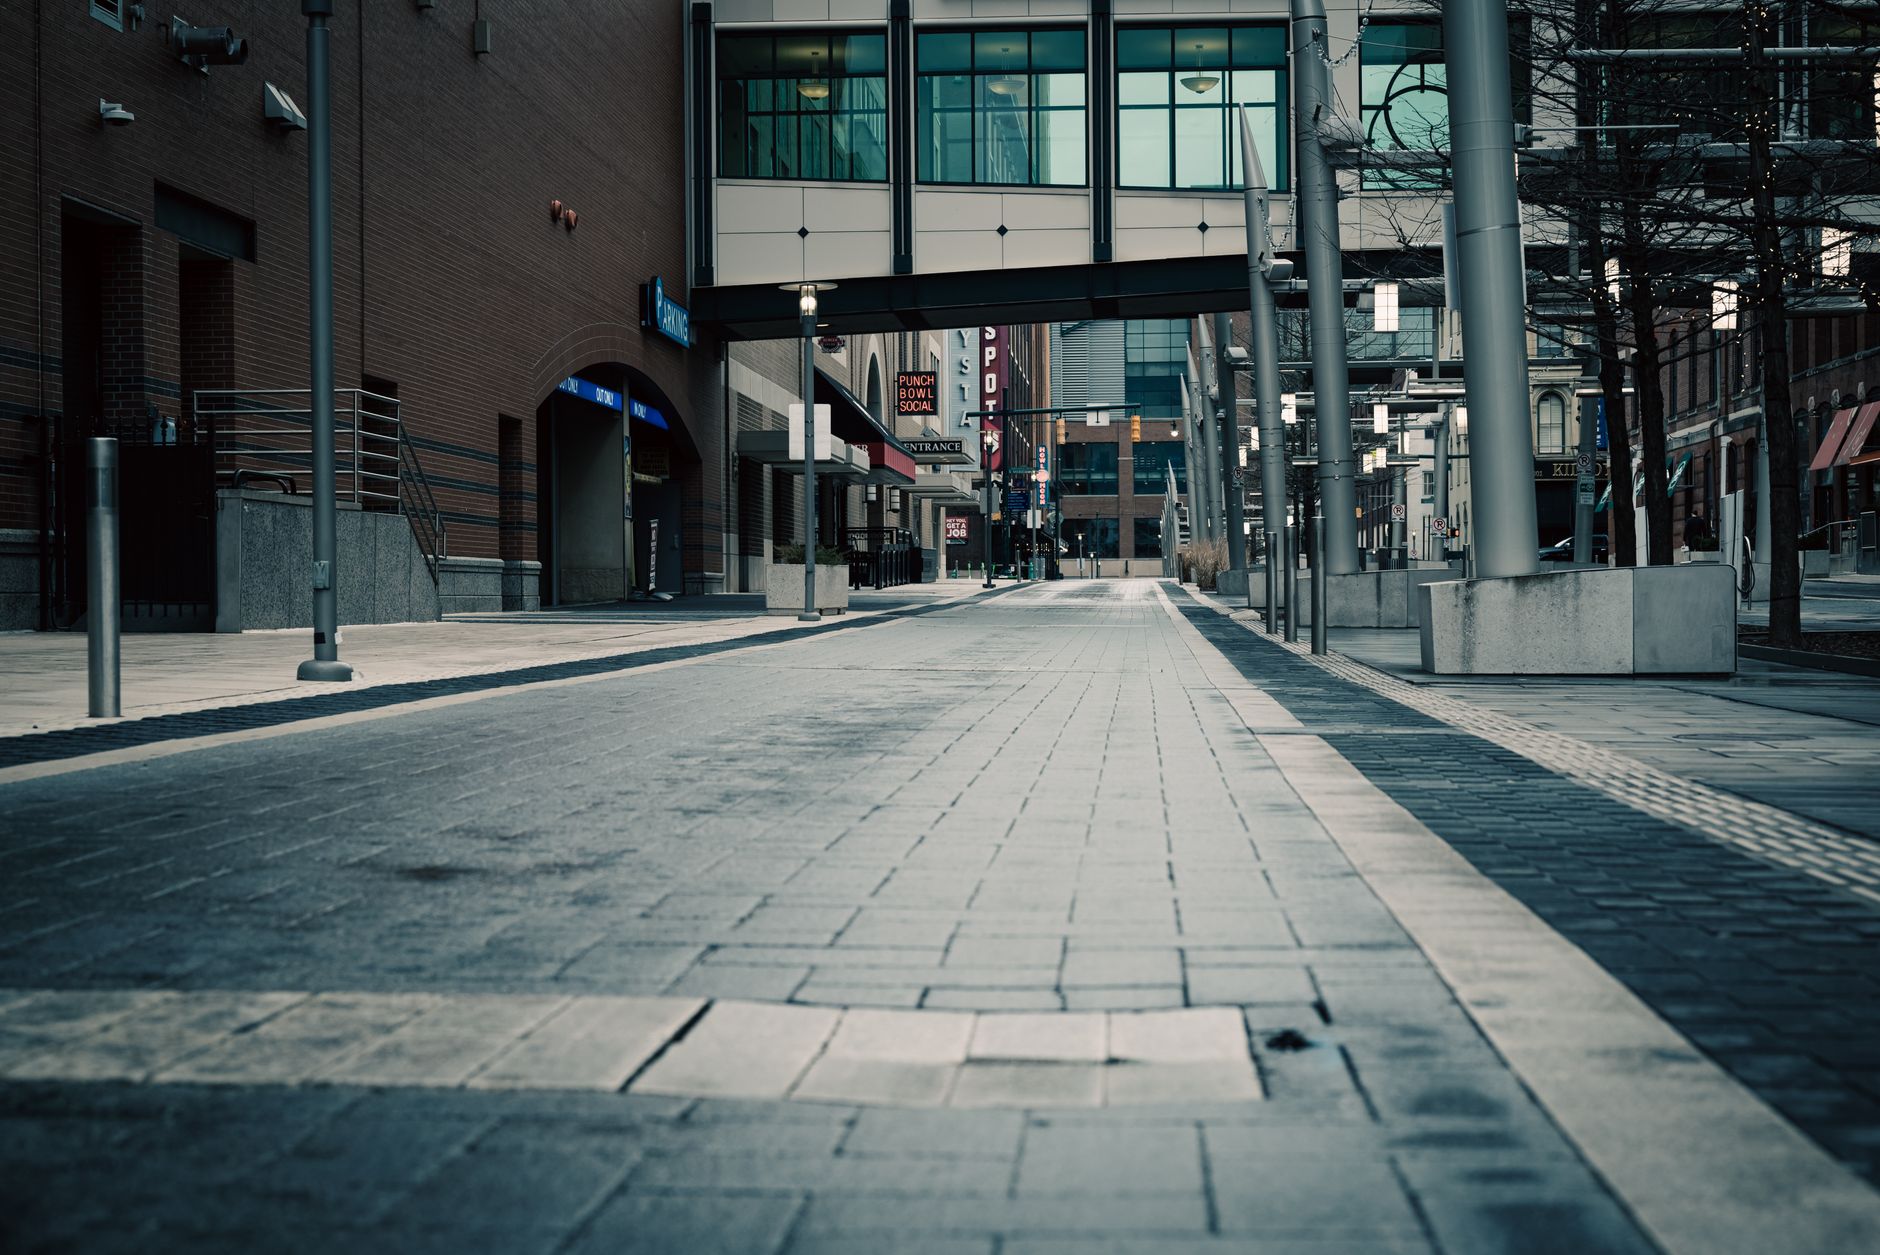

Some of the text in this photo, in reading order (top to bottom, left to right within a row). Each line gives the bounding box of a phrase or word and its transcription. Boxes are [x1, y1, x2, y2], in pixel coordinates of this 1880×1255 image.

[657, 286, 689, 341] PARKING
[899, 374, 935, 387] PUNCH
[899, 388, 934, 399] BOWL
[899, 400, 934, 412] SOCIAL
[946, 529, 967, 537] JOB
